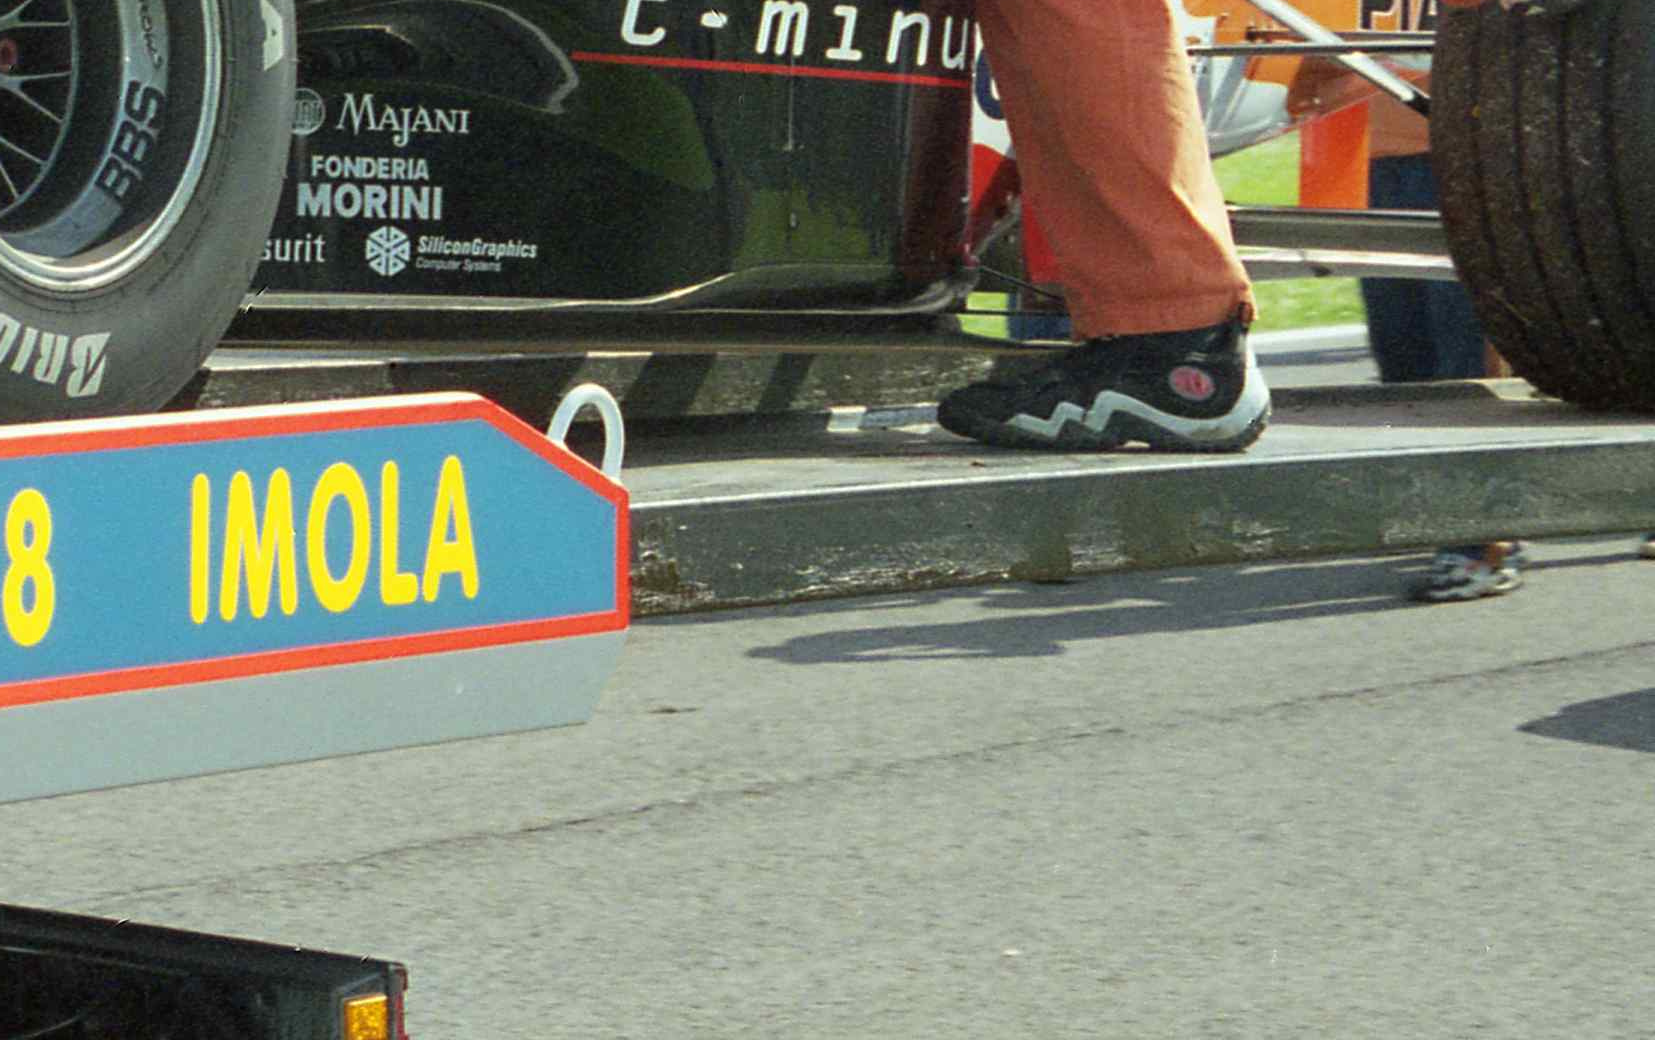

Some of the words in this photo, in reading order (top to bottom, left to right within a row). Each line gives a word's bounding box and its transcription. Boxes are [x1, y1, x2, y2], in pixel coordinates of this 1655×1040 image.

[94, 79, 168, 203] BBS
[311, 155, 430, 181] FONDERIA
[297, 182, 443, 221] MORINI
[189, 455, 481, 625] IMOLA
